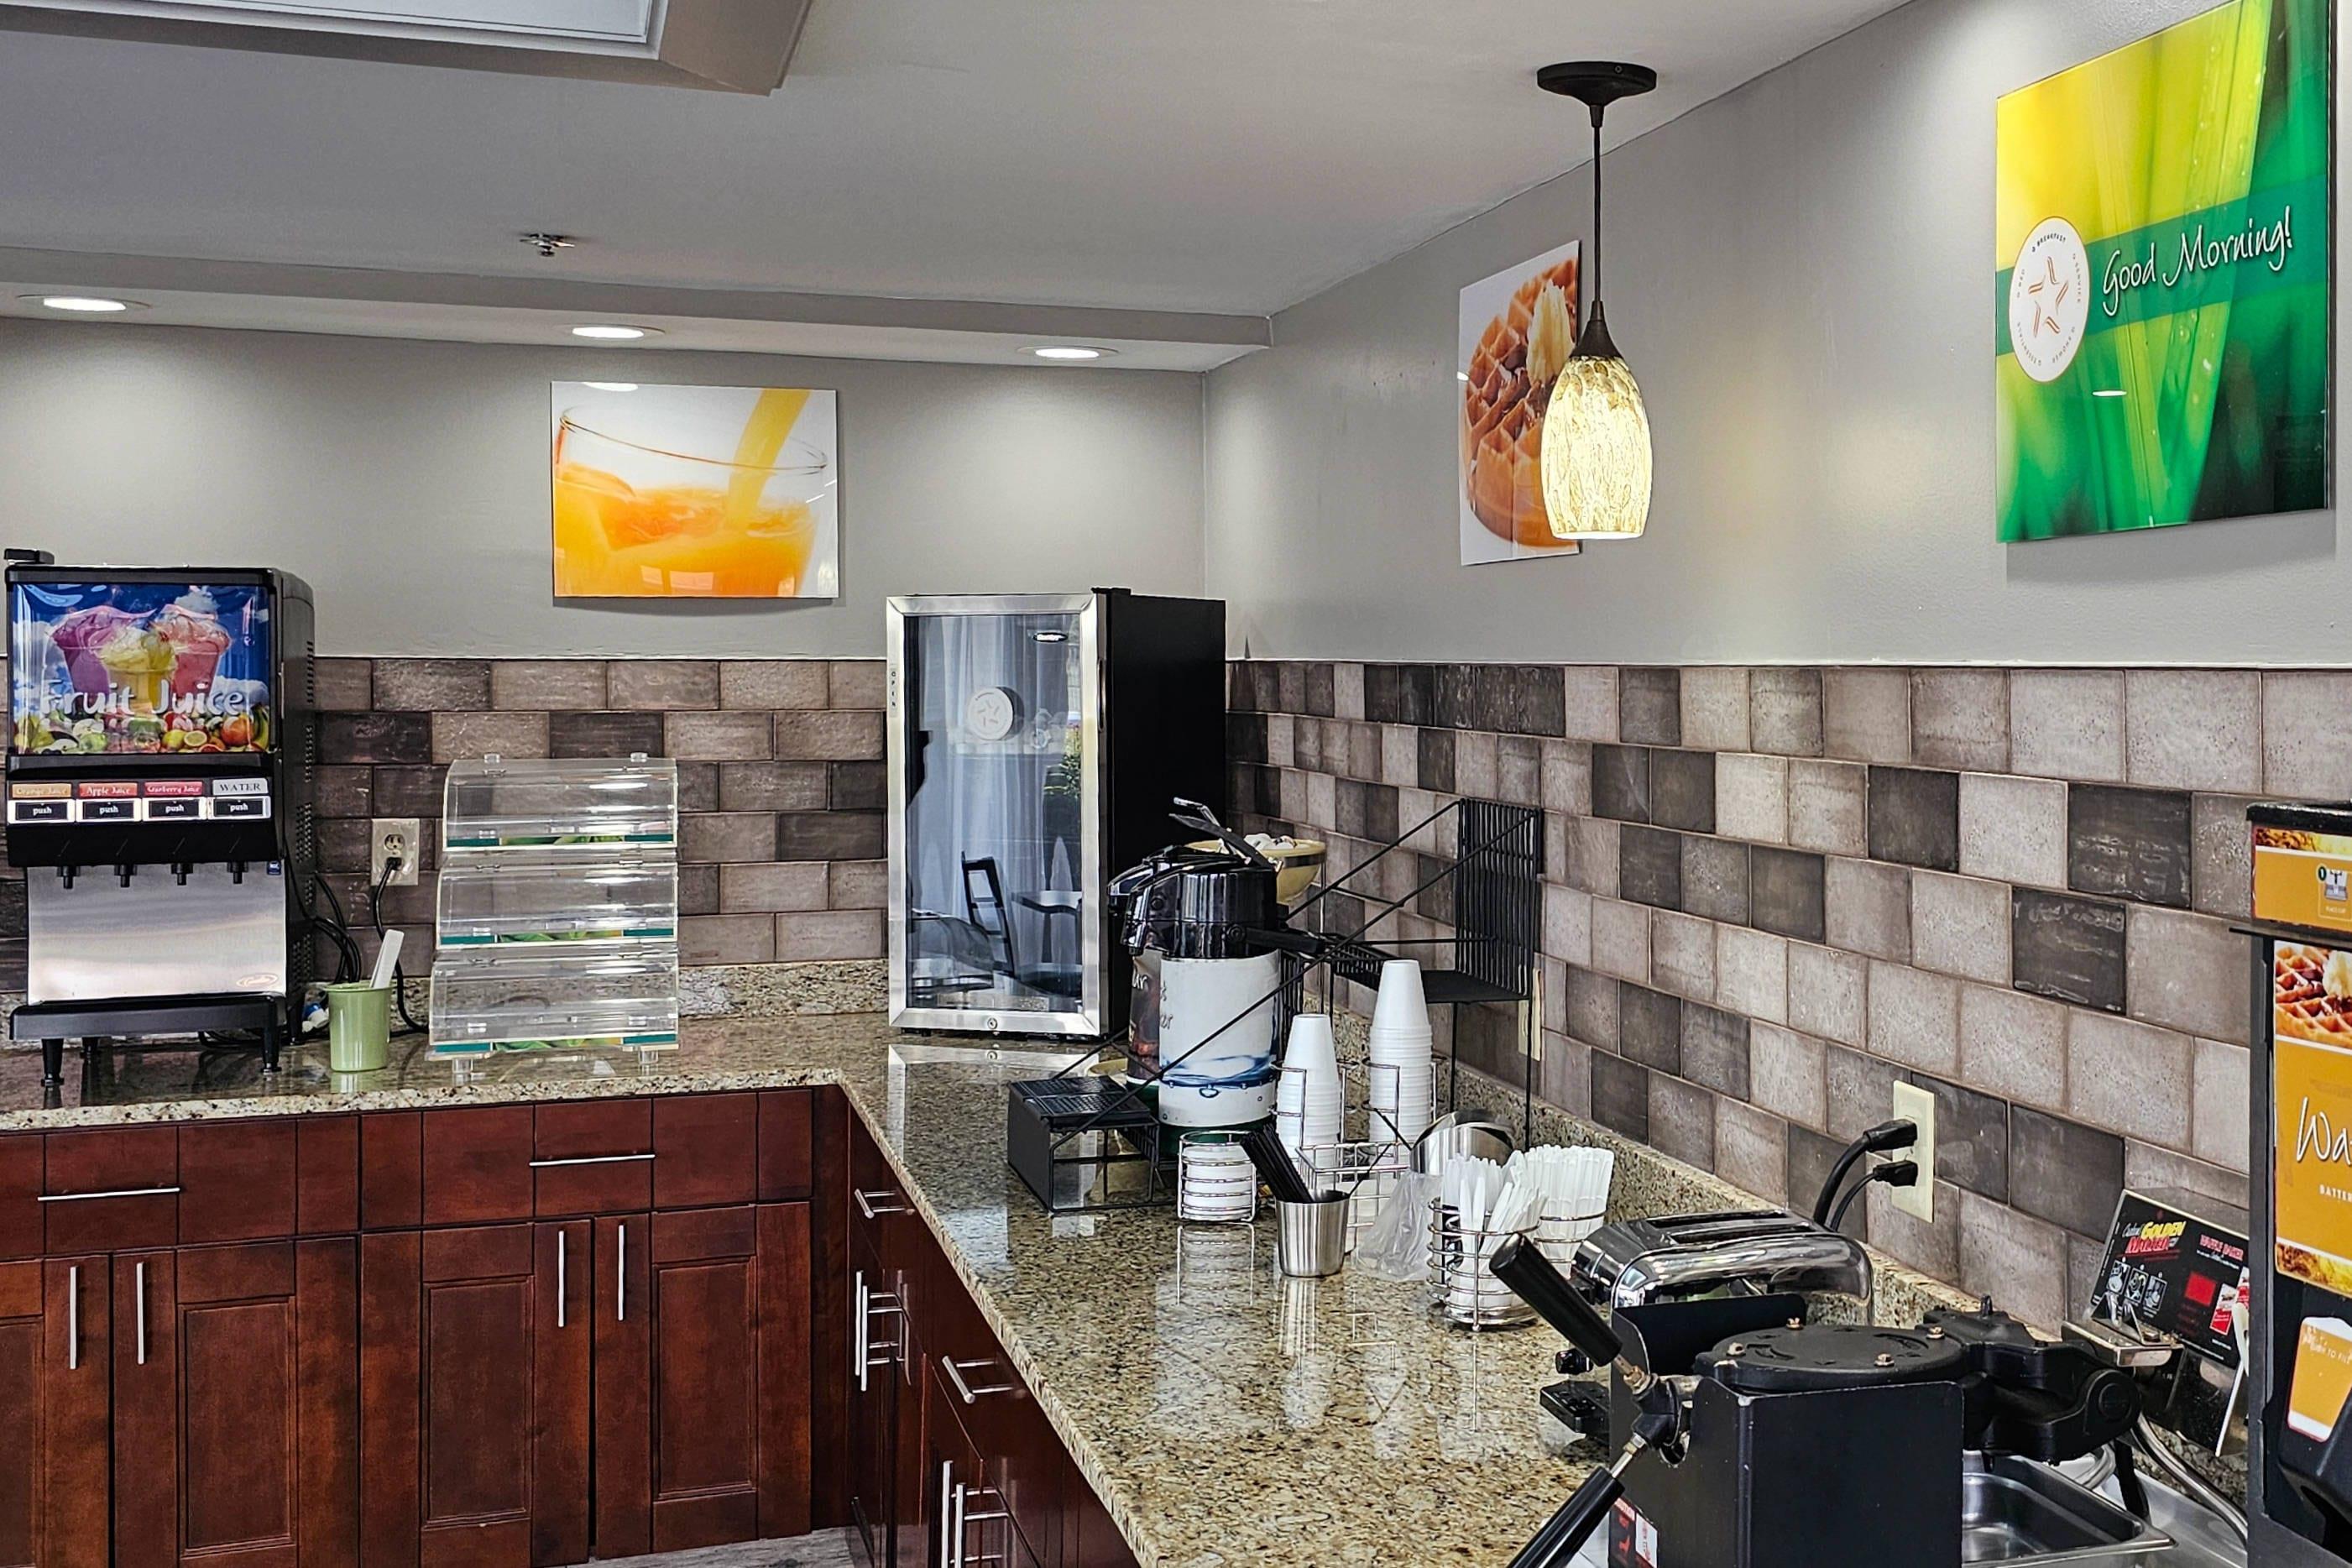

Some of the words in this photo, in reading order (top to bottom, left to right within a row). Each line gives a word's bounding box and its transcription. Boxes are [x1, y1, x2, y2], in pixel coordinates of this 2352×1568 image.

[2103, 242, 2156, 316] Good
[2161, 205, 2293, 287] Morning!
[41, 678, 135, 714] Fruit
[150, 678, 245, 715] Juice
[86, 787, 109, 797] Apple
[112, 787, 131, 795] Juice
[147, 785, 182, 794] Cranberry
[219, 782, 262, 792] WATER
[33, 806, 52, 816] push
[99, 805, 118, 815] push
[165, 804, 185, 813] push
[230, 803, 248, 812] push
[2297, 1096, 2352, 1166] Wa
[2141, 1220, 2187, 1240] GOLDEN
